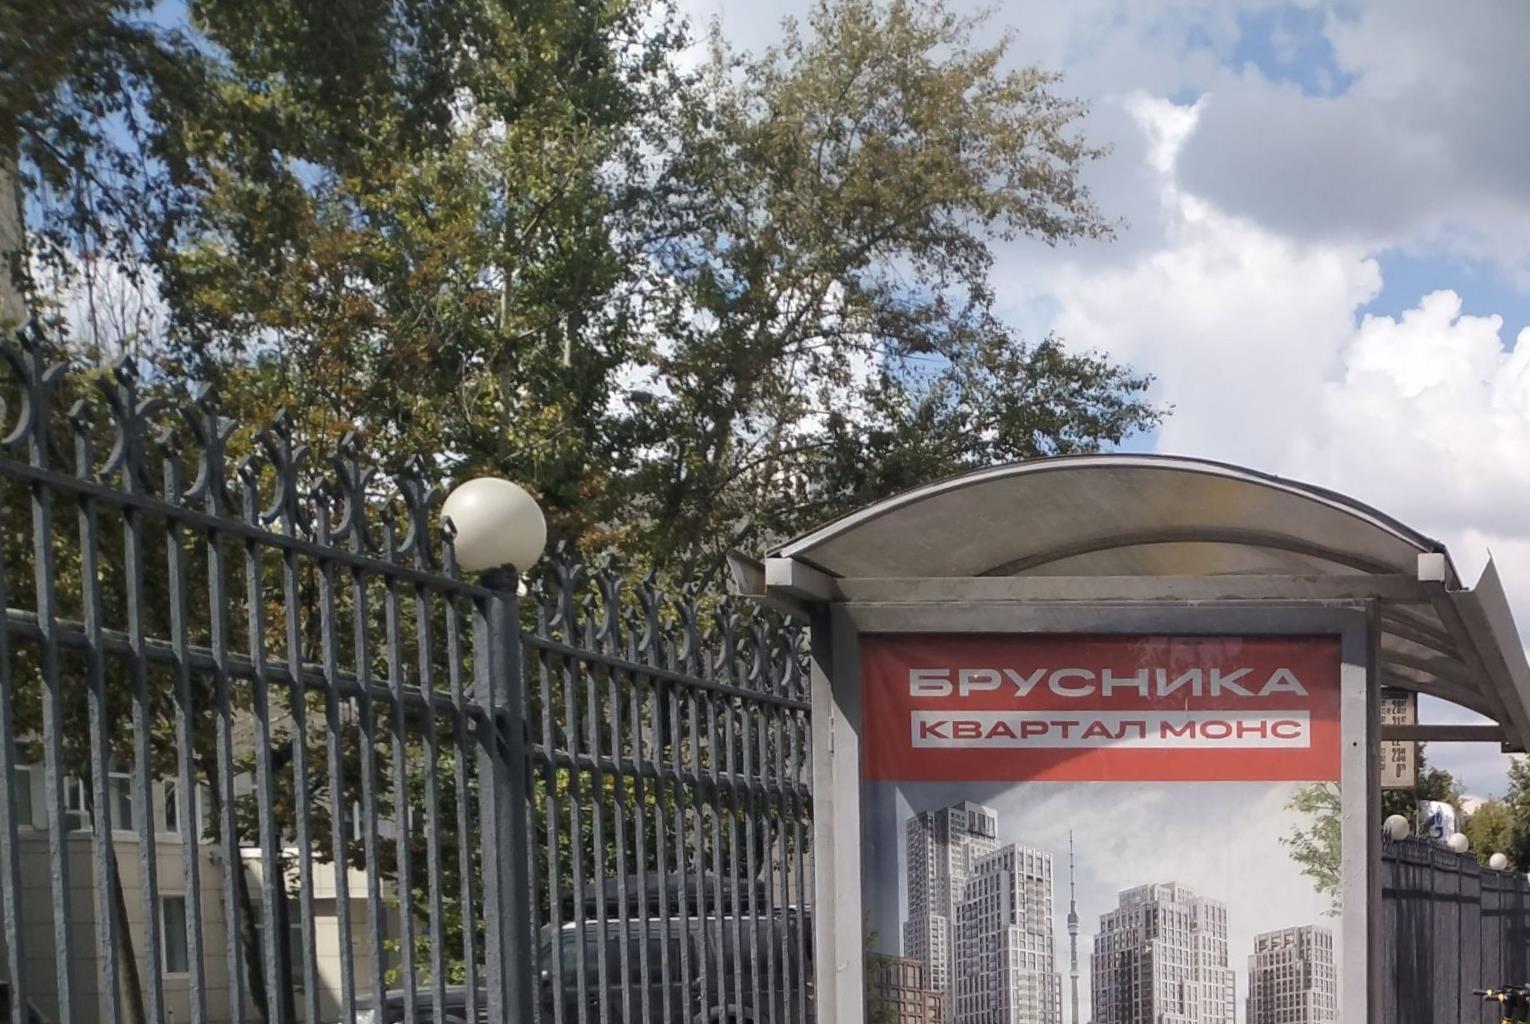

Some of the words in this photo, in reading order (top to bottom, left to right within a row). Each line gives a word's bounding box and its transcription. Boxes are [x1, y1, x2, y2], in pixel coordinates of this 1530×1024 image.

[909, 667, 1309, 698] БРУСНИКА
[919, 720, 1147, 740] КВАРТАЛ
[1160, 720, 1303, 740] МОНС
